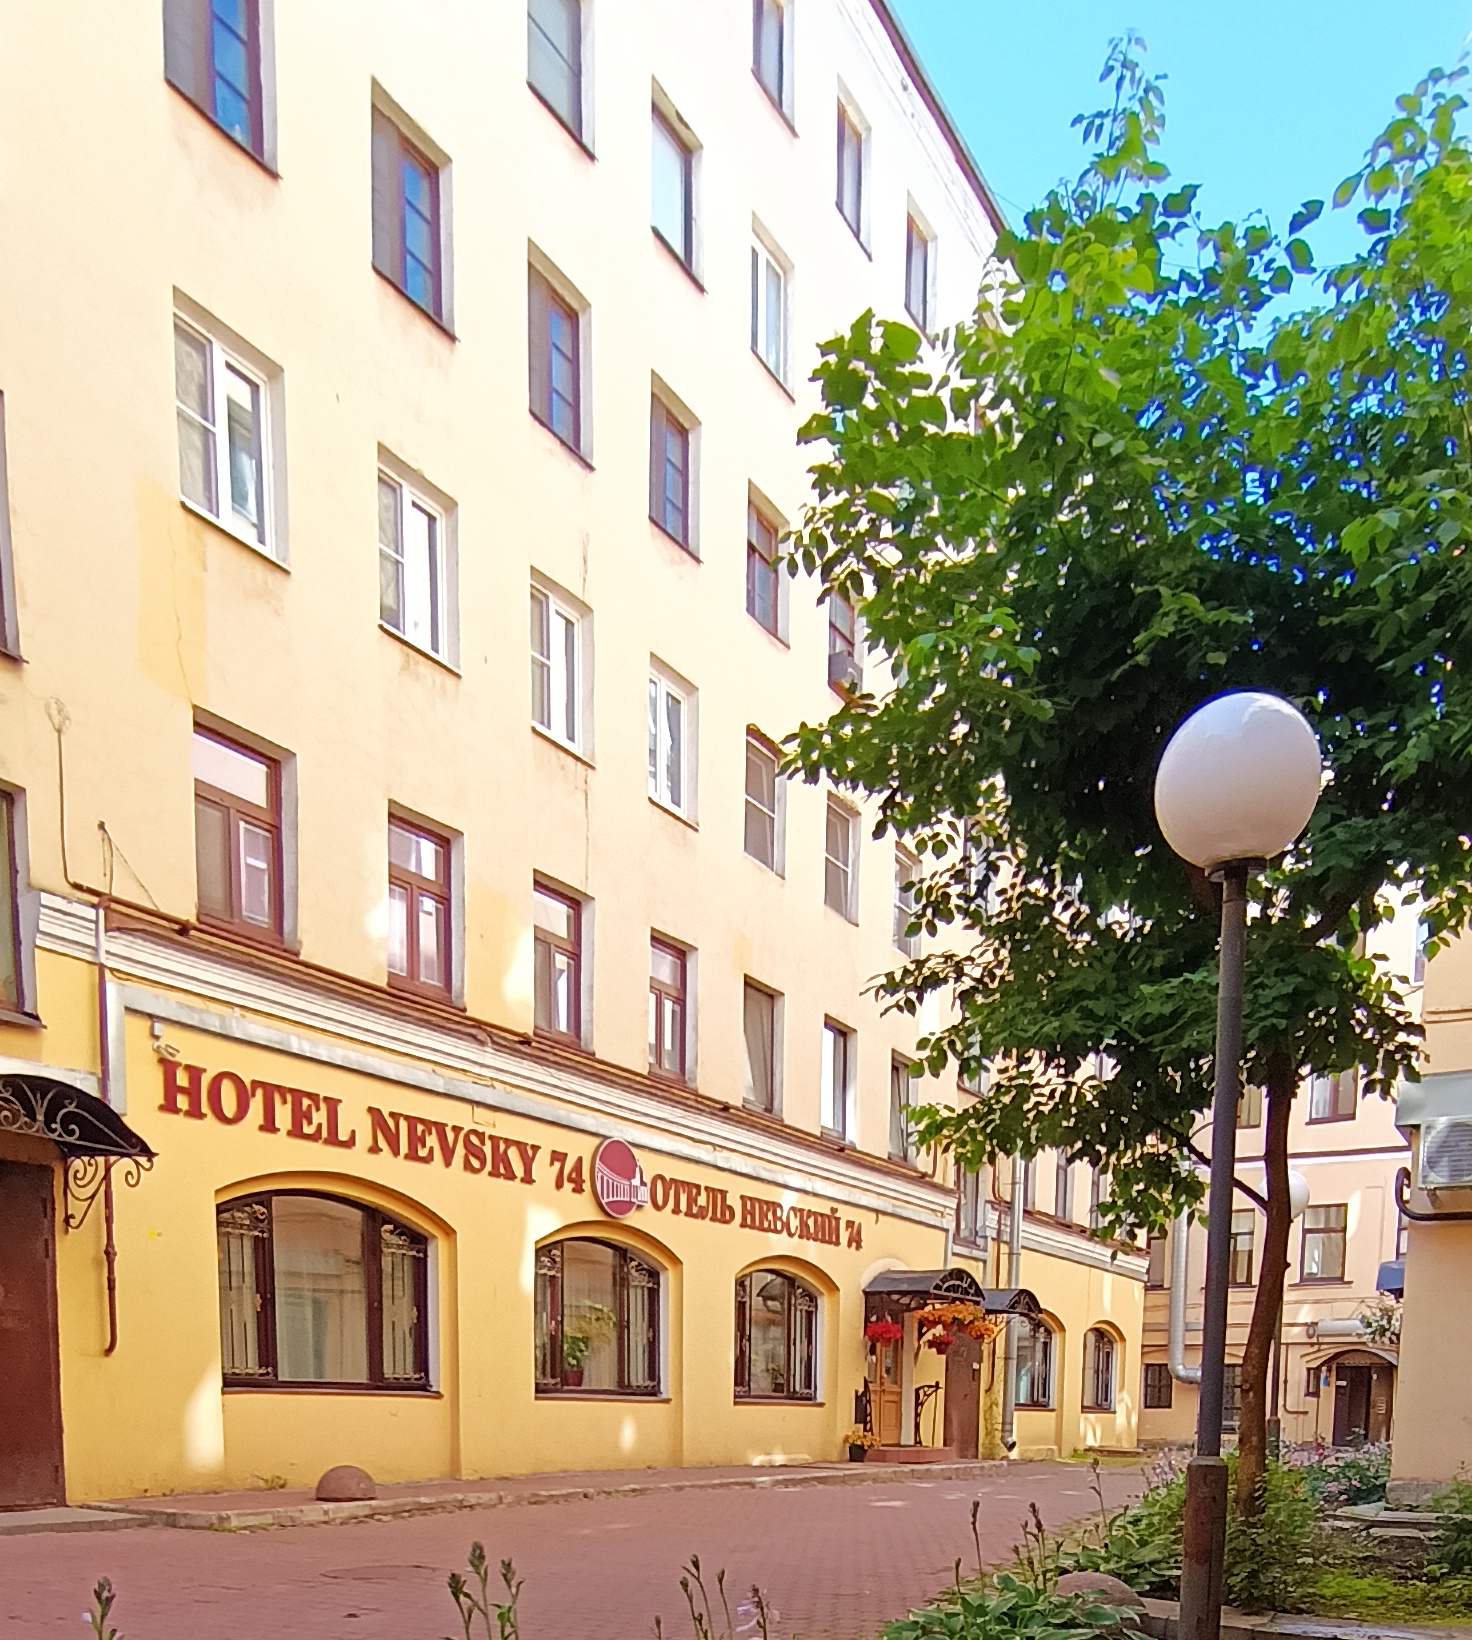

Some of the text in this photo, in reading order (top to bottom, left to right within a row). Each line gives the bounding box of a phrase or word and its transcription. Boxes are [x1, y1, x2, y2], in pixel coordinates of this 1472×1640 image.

[157, 1057, 586, 1194] HOTEL NEVSKY 74
[650, 1173, 863, 1251] ОТЕЛЬ НЕВСКИЙ 74
